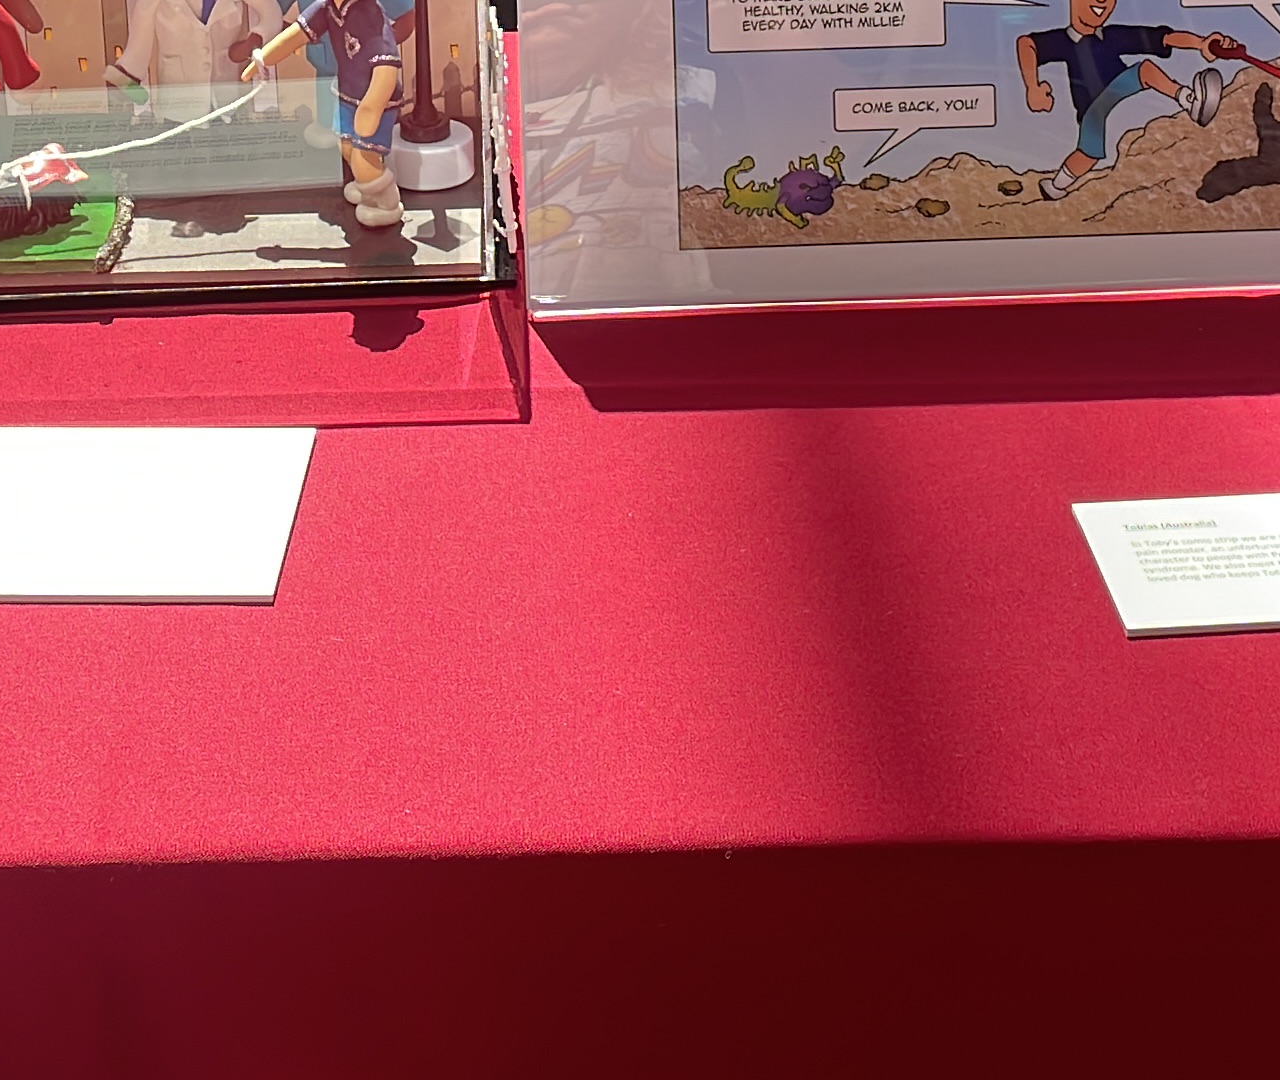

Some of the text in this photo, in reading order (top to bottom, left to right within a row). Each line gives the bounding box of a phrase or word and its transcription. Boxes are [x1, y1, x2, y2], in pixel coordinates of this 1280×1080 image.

[809, 2, 870, 16] WALKING
[874, 1, 903, 13] 2KM
[742, 14, 905, 32] EVERY DAY WITH MILLIE!
[852, 98, 978, 114] COME BACK, YOU!
